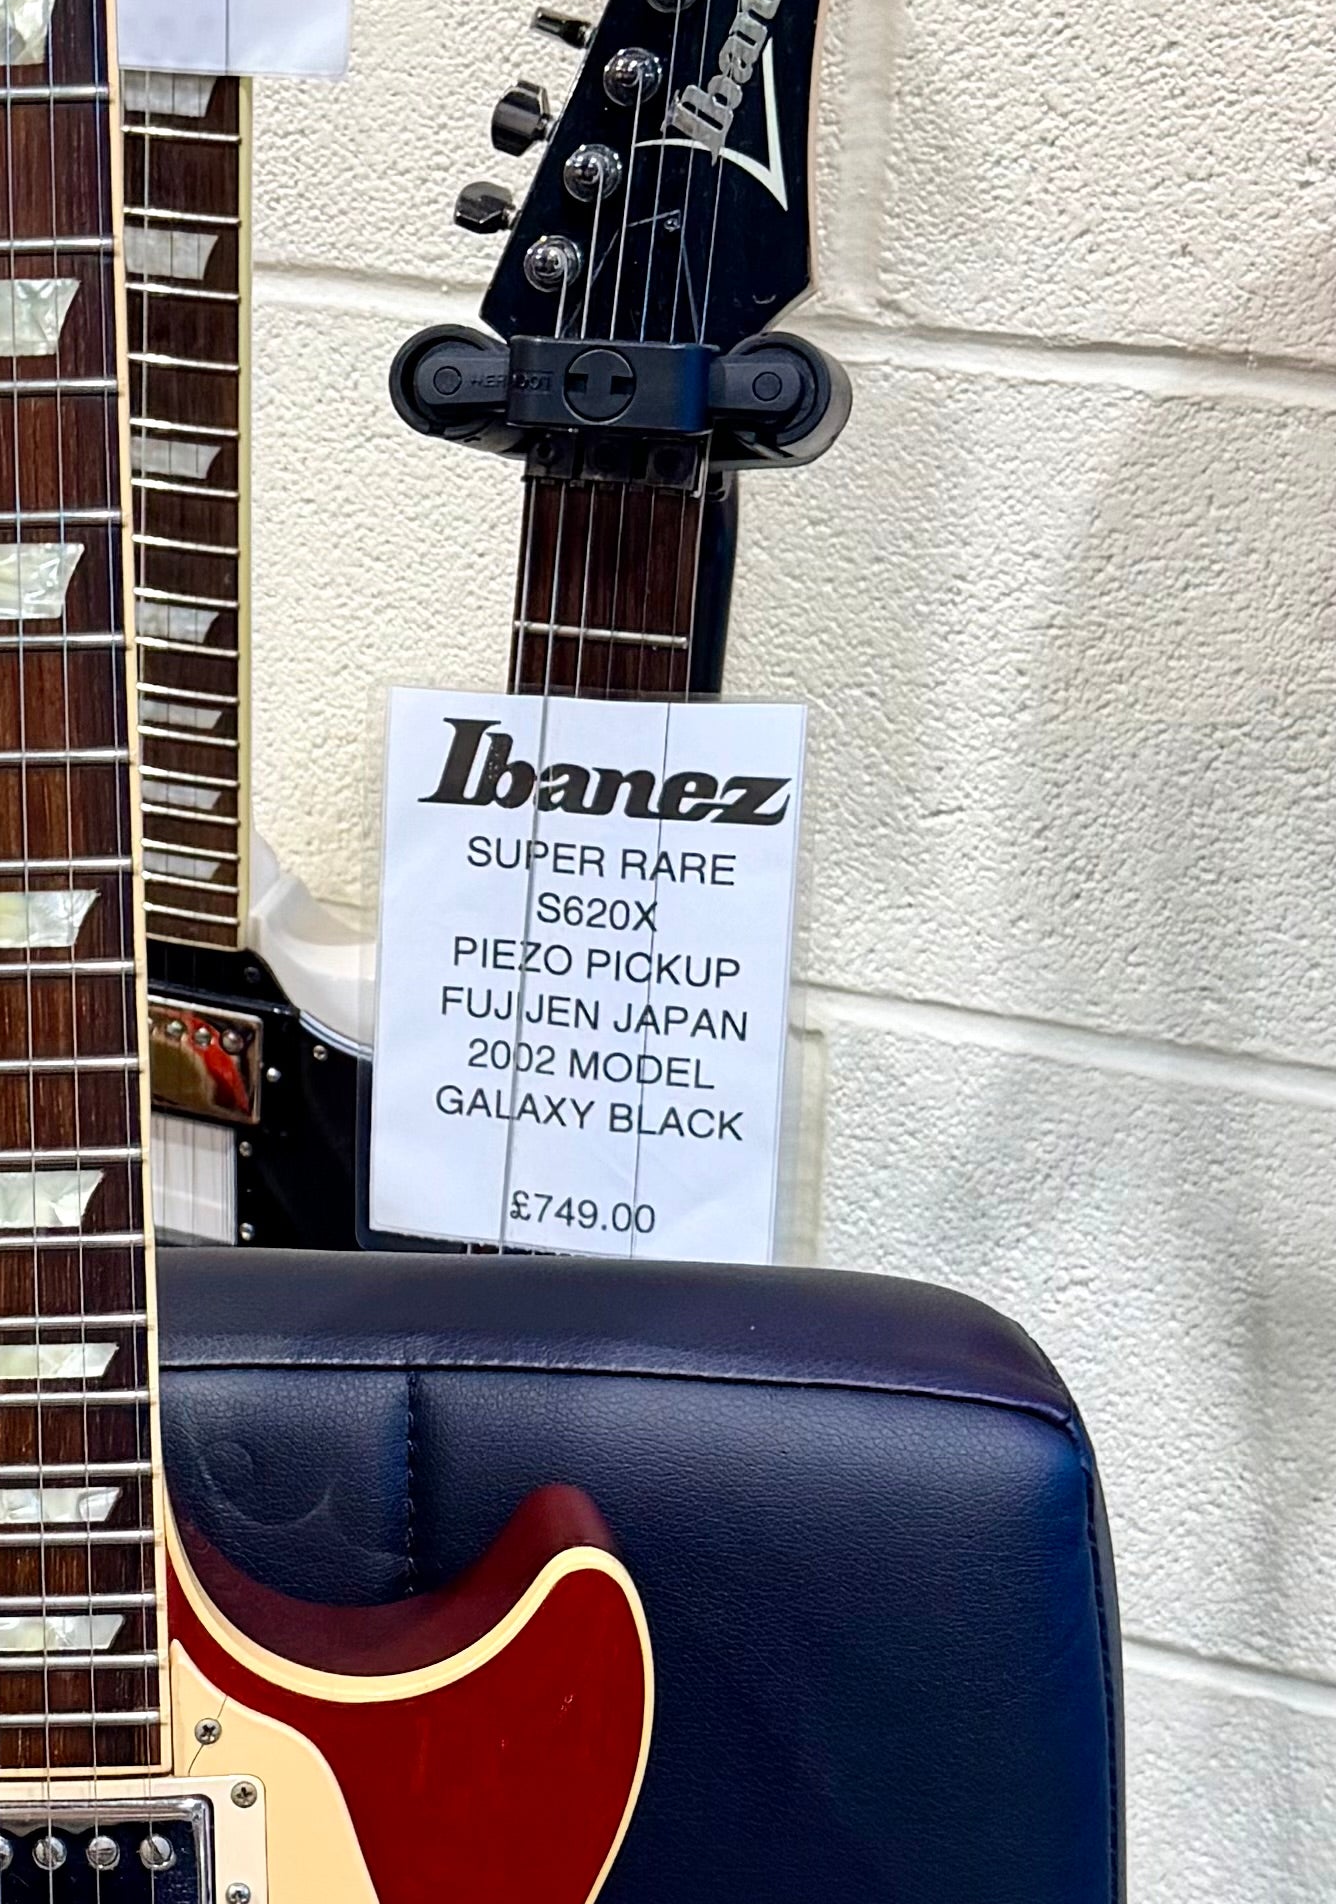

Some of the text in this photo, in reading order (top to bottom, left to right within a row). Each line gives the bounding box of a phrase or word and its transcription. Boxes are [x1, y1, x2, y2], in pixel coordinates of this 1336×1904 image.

[417, 717, 792, 826] Ibanez
[467, 836, 737, 886] SUPER RARE
[537, 892, 658, 933] S620X
[453, 936, 741, 989] PIEZO PICKUP
[613, 1003, 748, 1041] JAPAN
[467, 1038, 716, 1090] 2002 MODEL
[435, 1085, 744, 1141] GALAXY BLACK
[510, 1190, 656, 1234] £749.00
